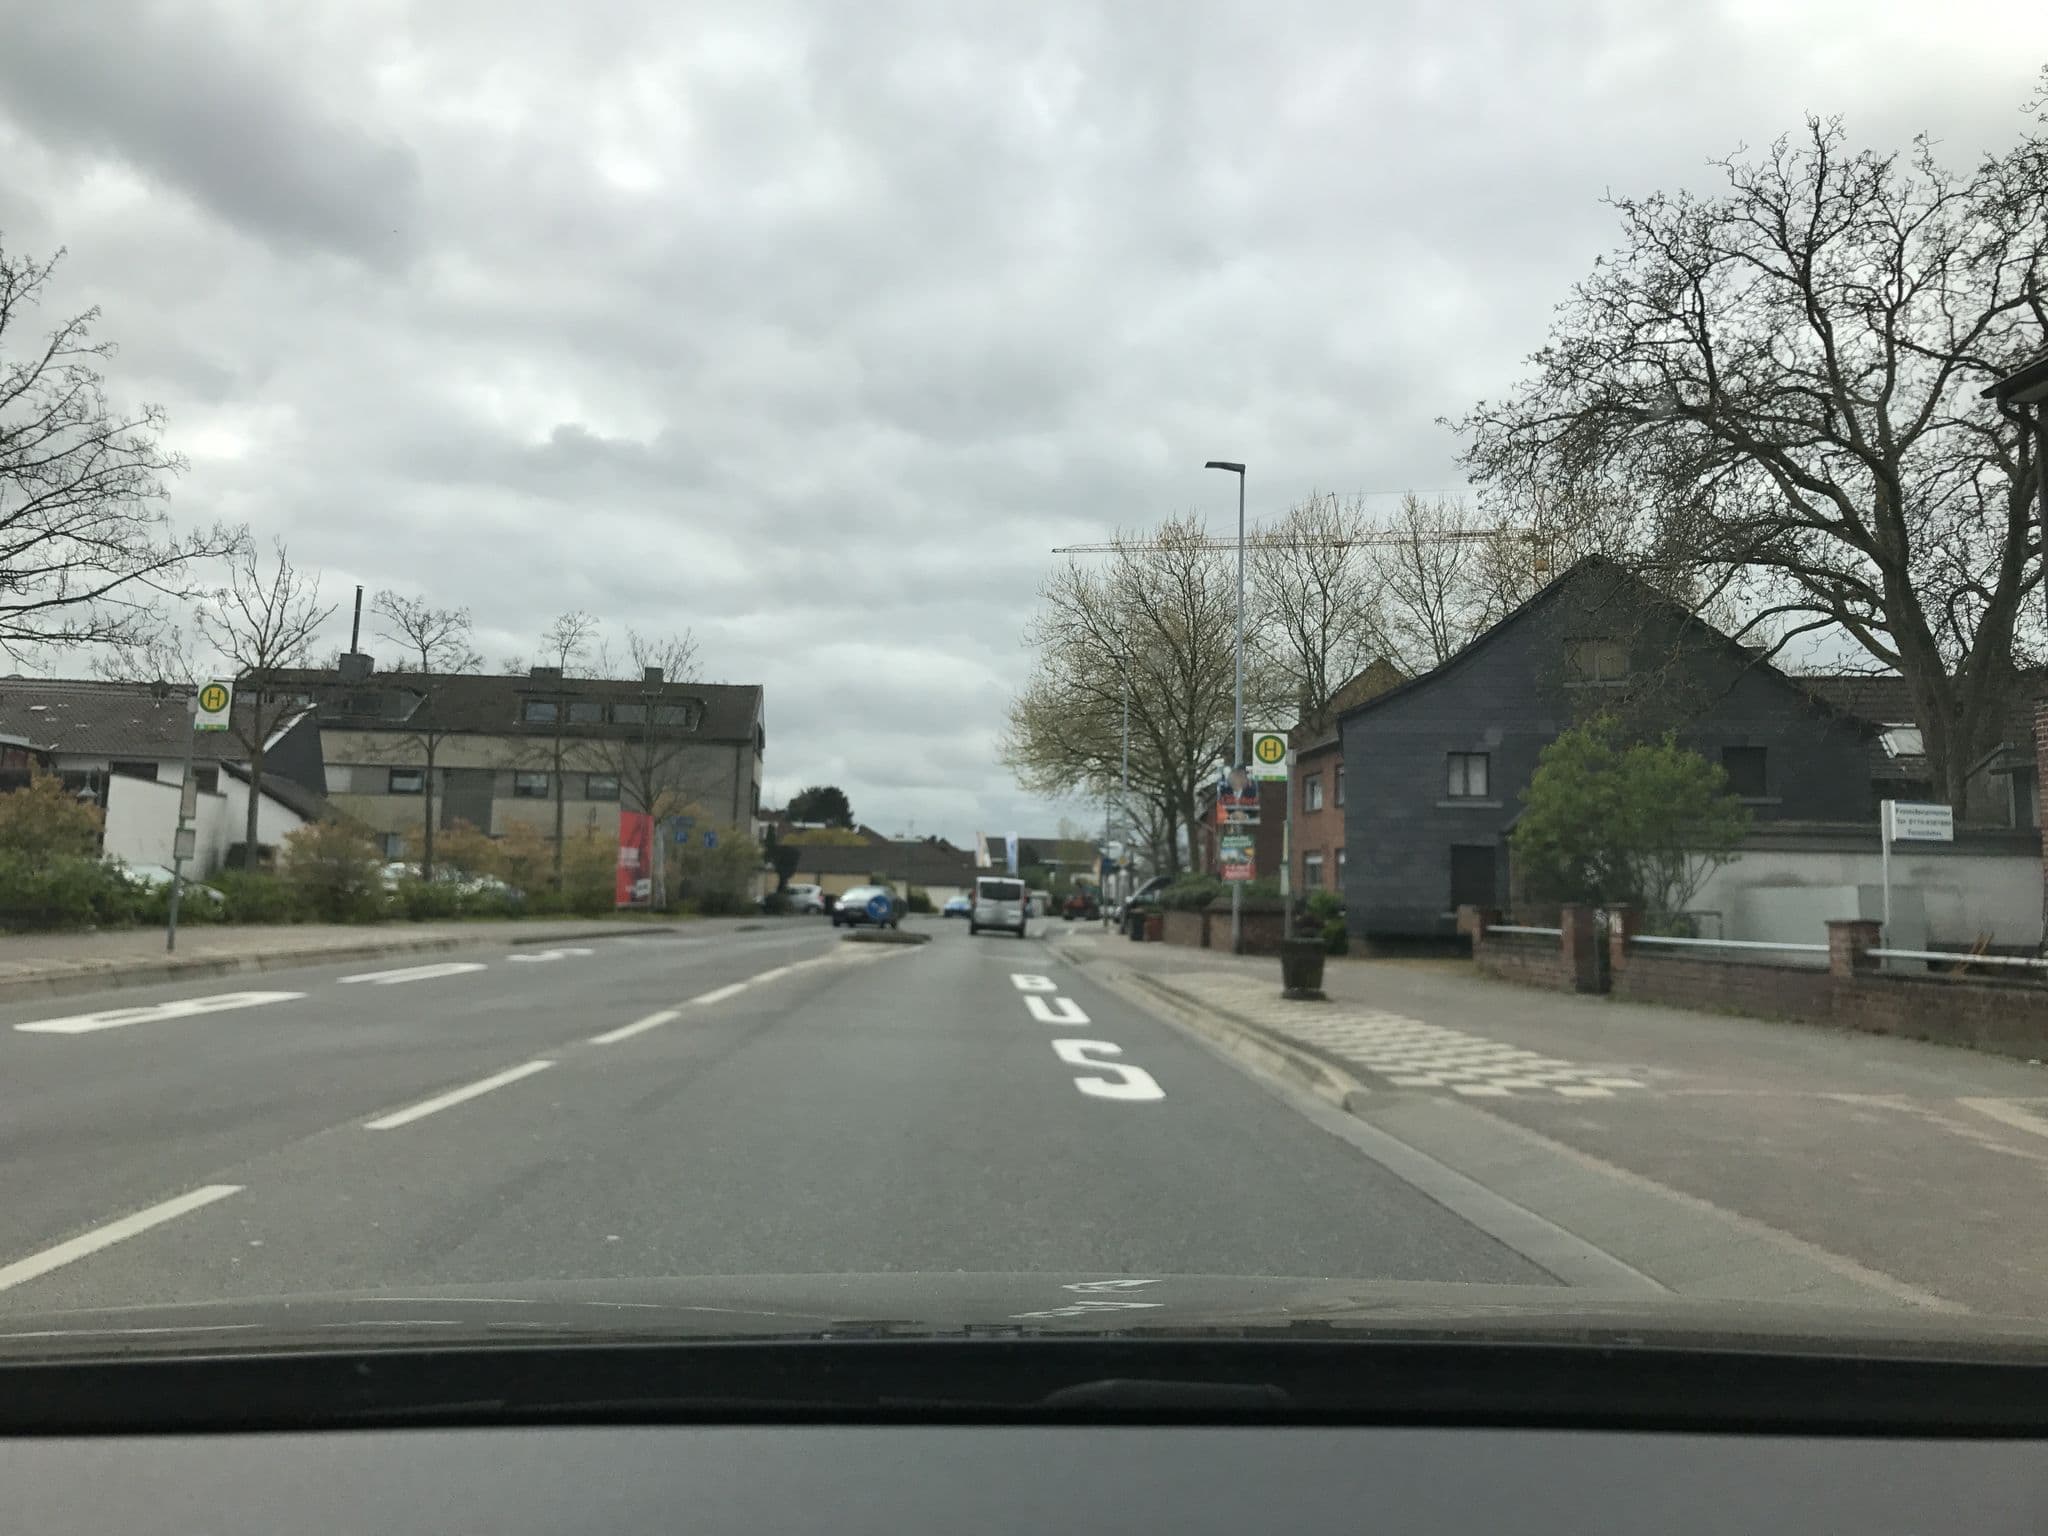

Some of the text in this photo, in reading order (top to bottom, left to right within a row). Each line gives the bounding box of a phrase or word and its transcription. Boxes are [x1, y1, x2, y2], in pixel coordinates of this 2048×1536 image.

[208, 690, 221, 706] H
[1264, 741, 1277, 757] H
[1010, 973, 1166, 1100] BUS
